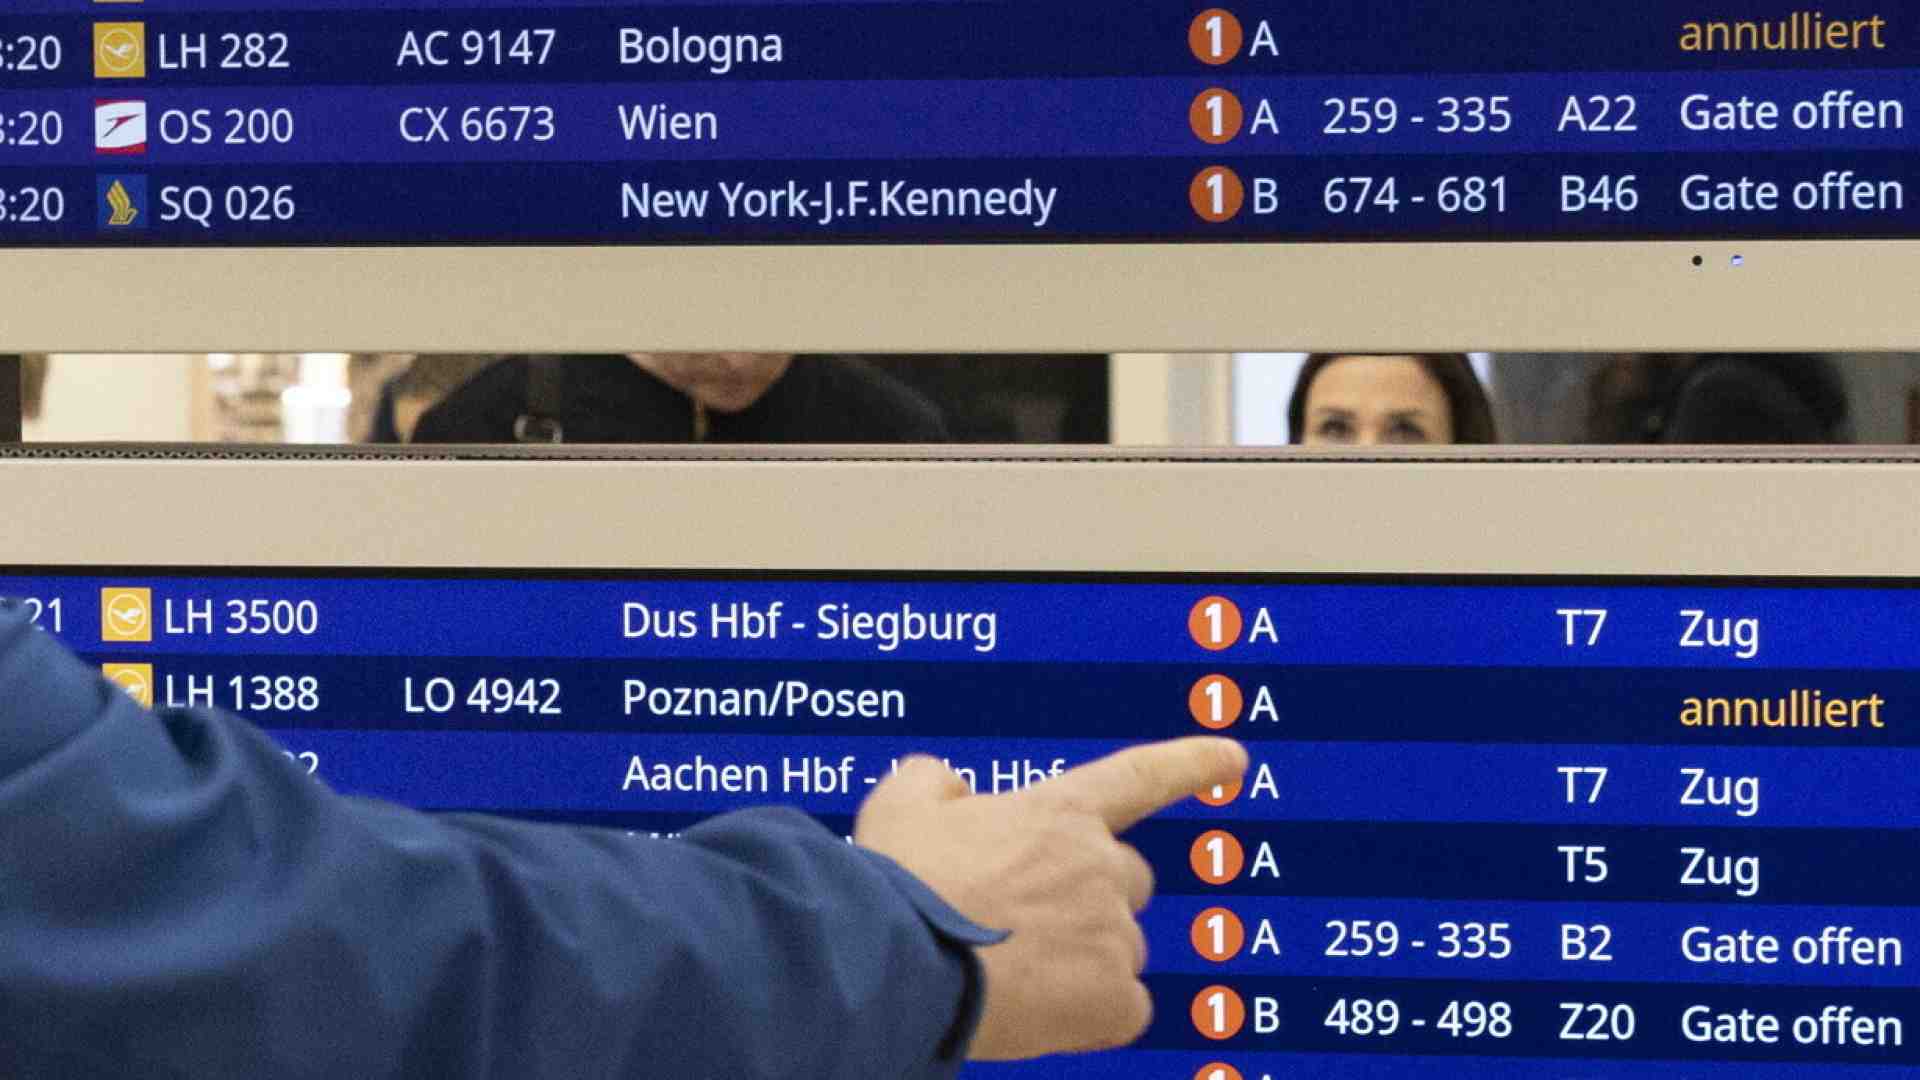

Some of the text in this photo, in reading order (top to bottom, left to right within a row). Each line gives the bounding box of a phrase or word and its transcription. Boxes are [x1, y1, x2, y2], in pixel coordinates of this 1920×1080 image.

[0, 12, 1884, 74] :20 LH 282 AC 9147 Bologna 1 A annulliert
[0, 110, 63, 146] :20
[160, 109, 211, 144] OS
[225, 108, 292, 143] 200
[400, 107, 449, 142] CX
[462, 106, 554, 141] 6673
[618, 104, 716, 140] Wien
[1206, 96, 1222, 136] 1
[1250, 99, 1279, 134] A
[1324, 98, 1397, 133] 259
[1438, 96, 1511, 132] 335
[1558, 95, 1637, 131] A22
[1681, 94, 1778, 130] Gate
[1793, 90, 1903, 129] offen
[161, 186, 212, 227] SQ
[226, 186, 294, 220] 026
[622, 183, 708, 217] New
[719, 179, 1056, 226] York-J.F.Kennedy
[1207, 174, 1223, 213] 1
[1254, 178, 1277, 213] B
[1325, 177, 1399, 212] 674
[1438, 176, 1504, 212] 681
[1562, 175, 1638, 211] B46
[1681, 175, 1778, 210] Gate
[1793, 171, 1902, 209] offen
[166, 599, 211, 634] LH
[226, 600, 317, 634] 3500
[624, 602, 697, 638] Dus
[712, 601, 783, 639] Hbf
[818, 603, 996, 652] Siegburg
[1205, 603, 1222, 643] 1
[1249, 608, 1278, 643] A
[1557, 609, 1607, 645] T7
[1680, 610, 1758, 658] Zug
[166, 674, 1884, 727] LH 1388 LO 4942 Poznan/Posen 1 A annulliert
[623, 755, 767, 792] Aachen
[784, 756, 855, 793] Hbf
[1247, 762, 1279, 799] A
[1557, 767, 1607, 803] T7
[1680, 768, 1758, 816] Zug
[1206, 837, 1759, 896] 1 A T5 Zug
[1207, 914, 1224, 954] 1
[1251, 919, 1280, 954] A
[1325, 920, 1398, 956] 259
[1438, 922, 1511, 959] 335
[1562, 924, 1612, 960] B2
[1682, 927, 1779, 963] Gate
[1793, 926, 1901, 965] offen
[1208, 992, 1225, 1032] 1
[1255, 997, 1279, 1033] B
[1324, 999, 1399, 1035] 489
[1437, 1001, 1512, 1037] 498
[1560, 1003, 1634, 1040] Z20
[1682, 1006, 1779, 1043] Gate
[1793, 1006, 1901, 1045] offen
